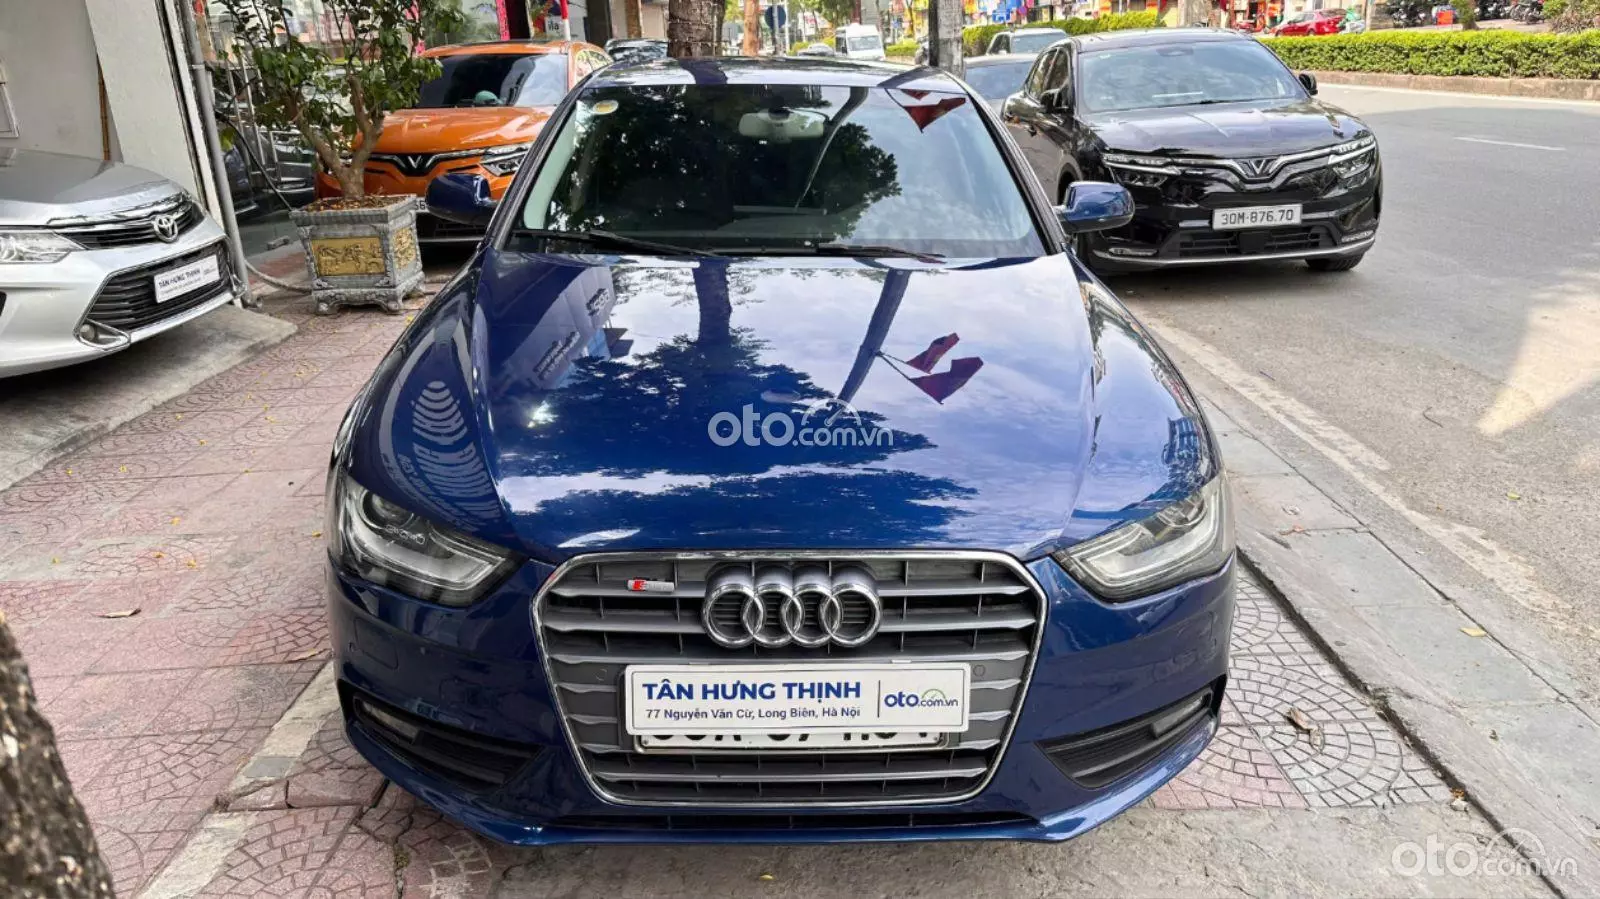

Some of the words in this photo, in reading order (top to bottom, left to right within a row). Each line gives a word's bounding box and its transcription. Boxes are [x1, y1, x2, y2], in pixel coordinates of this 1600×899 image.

[642, 679, 693, 700] TÂN
[702, 680, 775, 700] HƯNG
[782, 680, 861, 703] THỊNH
[884, 691, 958, 708] oto.com.vn
[646, 709, 660, 719] 77
[664, 708, 708, 720] Nguyễn
[711, 708, 733, 719] Văn
[758, 708, 787, 720] Long
[790, 707, 818, 719] Biên,
[822, 706, 837, 718] Hà
[841, 706, 860, 719] Nội
